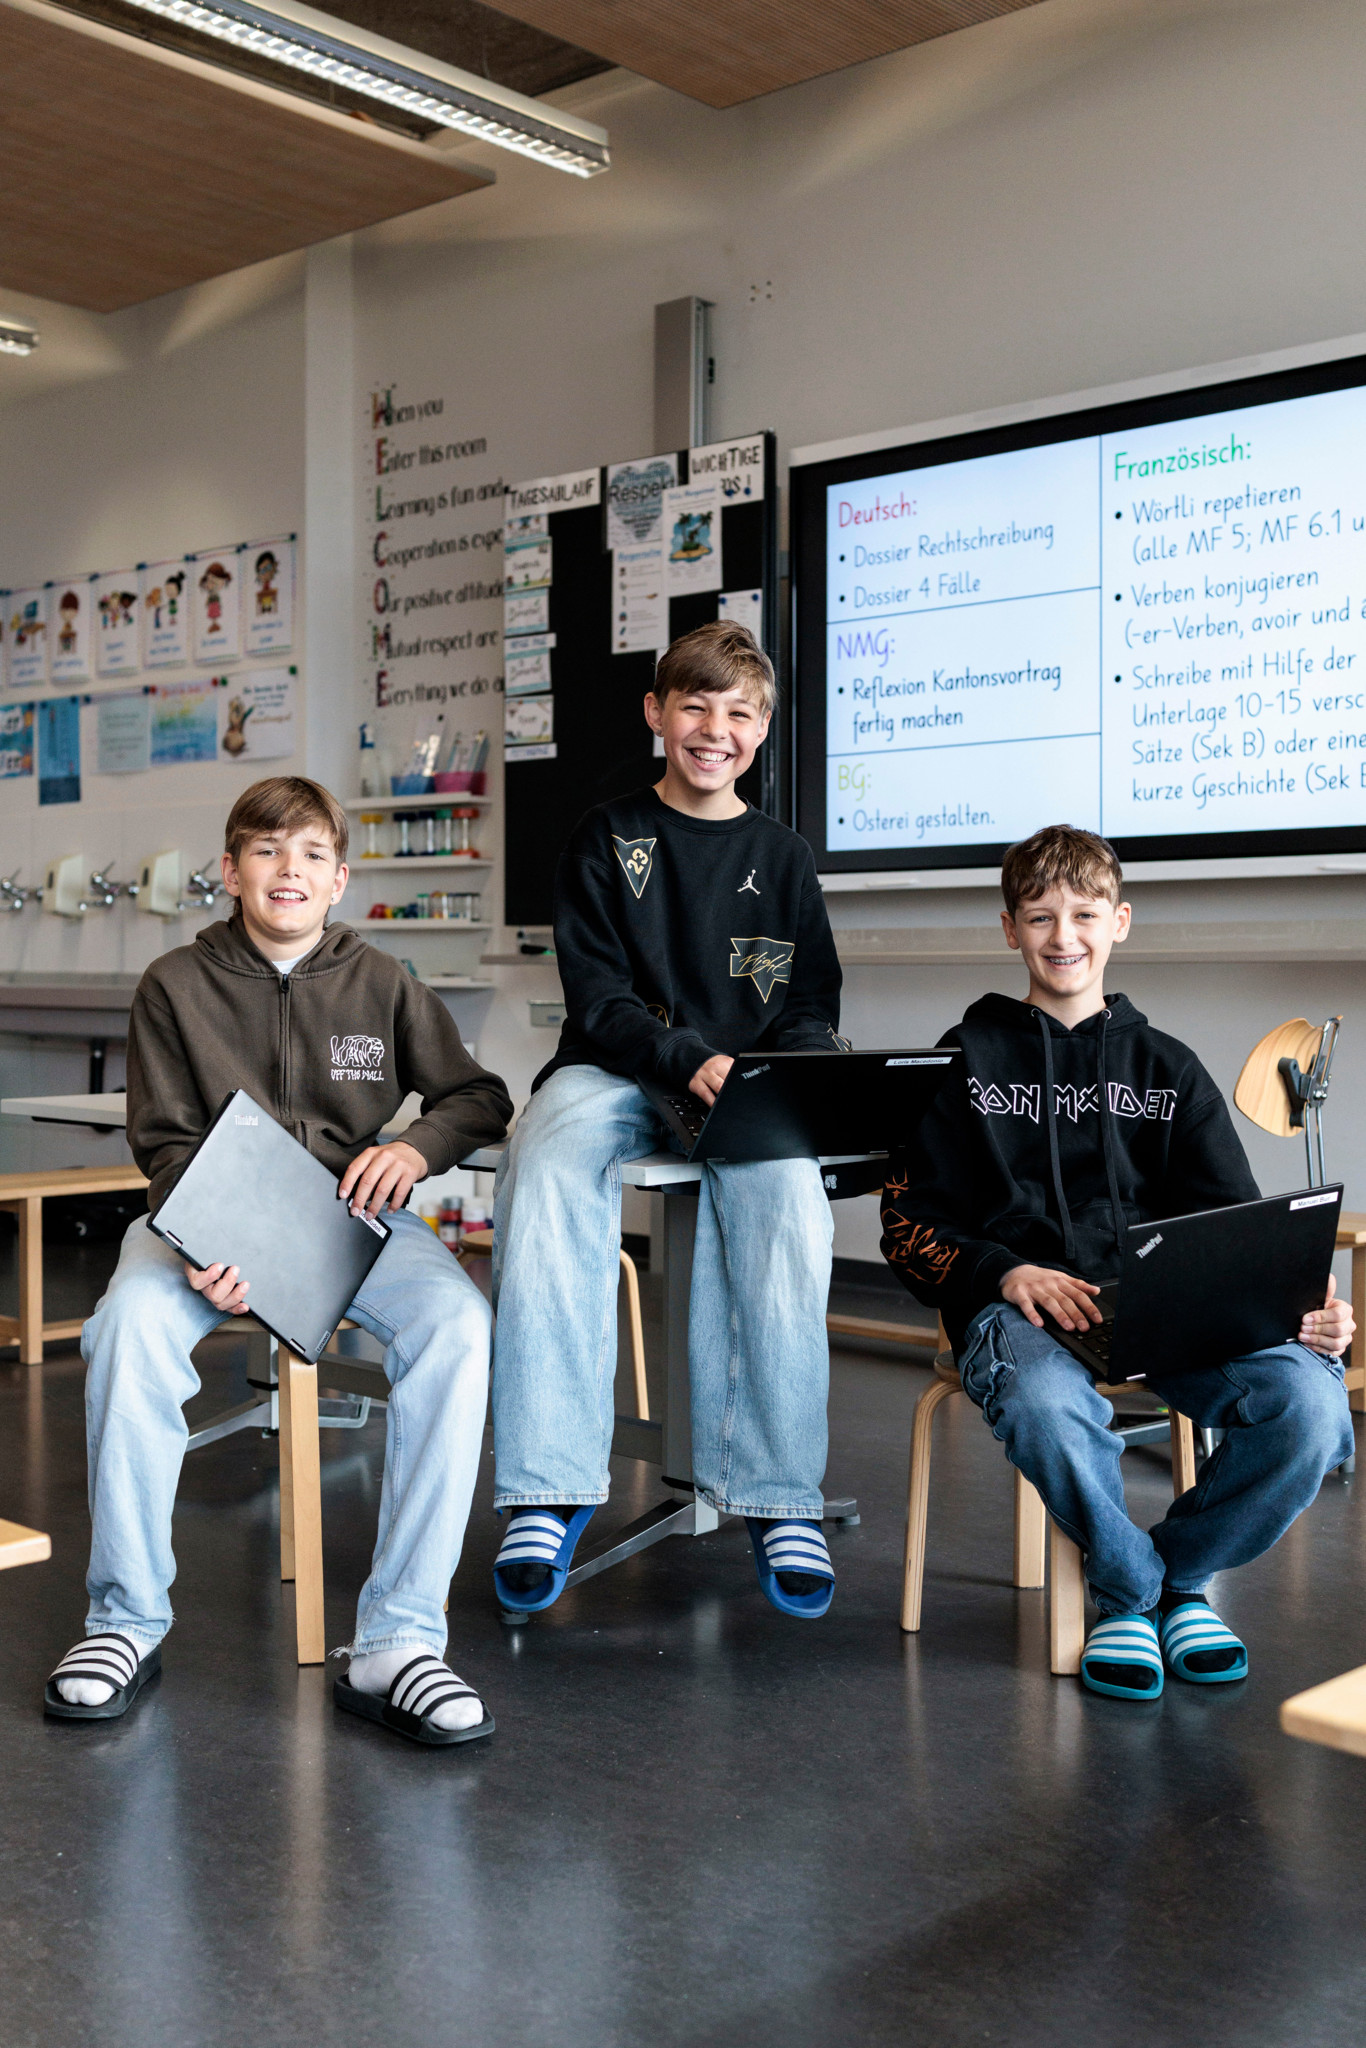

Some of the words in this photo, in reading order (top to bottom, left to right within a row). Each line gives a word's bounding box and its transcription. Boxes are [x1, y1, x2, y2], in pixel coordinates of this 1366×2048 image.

[416, 398, 444, 421] you
[376, 437, 415, 476] Enter
[445, 437, 487, 459] room
[1115, 433, 1252, 481] Französisch:
[376, 485, 436, 521] Learning
[451, 486, 474, 507] fun
[839, 492, 917, 528] Deutsch:
[1132, 494, 1195, 525] Wörtli
[1204, 484, 1301, 523] repetieren
[854, 545, 911, 568] Dossier
[918, 520, 1054, 557] Rechtschreibung
[1133, 533, 1177, 566] (alle
[1186, 526, 1223, 556] MF
[1232, 523, 1251, 553] 5;
[1260, 516, 1299, 545] MF
[1308, 509, 1341, 539] 6.1
[404, 588, 454, 616] positive
[854, 586, 911, 608] Dossier
[918, 577, 930, 598] 4
[938, 570, 980, 596] Fälle
[1131, 580, 1195, 608] Verben
[1205, 567, 1319, 606] konjugieren
[1124, 614, 1244, 648] (-er-Verben,
[1251, 607, 1302, 632] avoir
[1312, 596, 1350, 625] und
[423, 630, 471, 656] respect
[474, 630, 498, 648] are
[837, 628, 895, 668] NMG:
[471, 676, 489, 694] do
[853, 677, 925, 709] Reflexion
[933, 660, 1061, 692] Kantonsvortrag
[1132, 661, 1211, 691] Schreibe
[1221, 654, 1253, 682] mit
[1263, 648, 1314, 685] Hilfe
[1323, 645, 1356, 672] der
[853, 710, 894, 743] fertig
[902, 704, 963, 731] machen
[1132, 699, 1227, 733] Unterlage
[1234, 688, 1301, 718] 10-15
[1132, 739, 1182, 766] Sätze
[1191, 731, 1233, 762] (Sek
[1243, 727, 1266, 758] B)
[1274, 726, 1318, 754] oder
[838, 763, 871, 801] BG:
[1132, 778, 1183, 802] kurze
[1192, 769, 1295, 809] Geschichte
[1305, 762, 1350, 795] (Sek
[853, 809, 908, 832] Osterei
[916, 804, 995, 838] gestalten.
[626, 848, 648, 875] 23
[738, 951, 789, 977] Flight
[330, 1035, 385, 1068] VANS
[741, 1063, 771, 1080] ThinkPad
[967, 1077, 1041, 1124] RON
[235, 1114, 259, 1126] ThinkPad
[1136, 1233, 1164, 1259] ThinkPad
